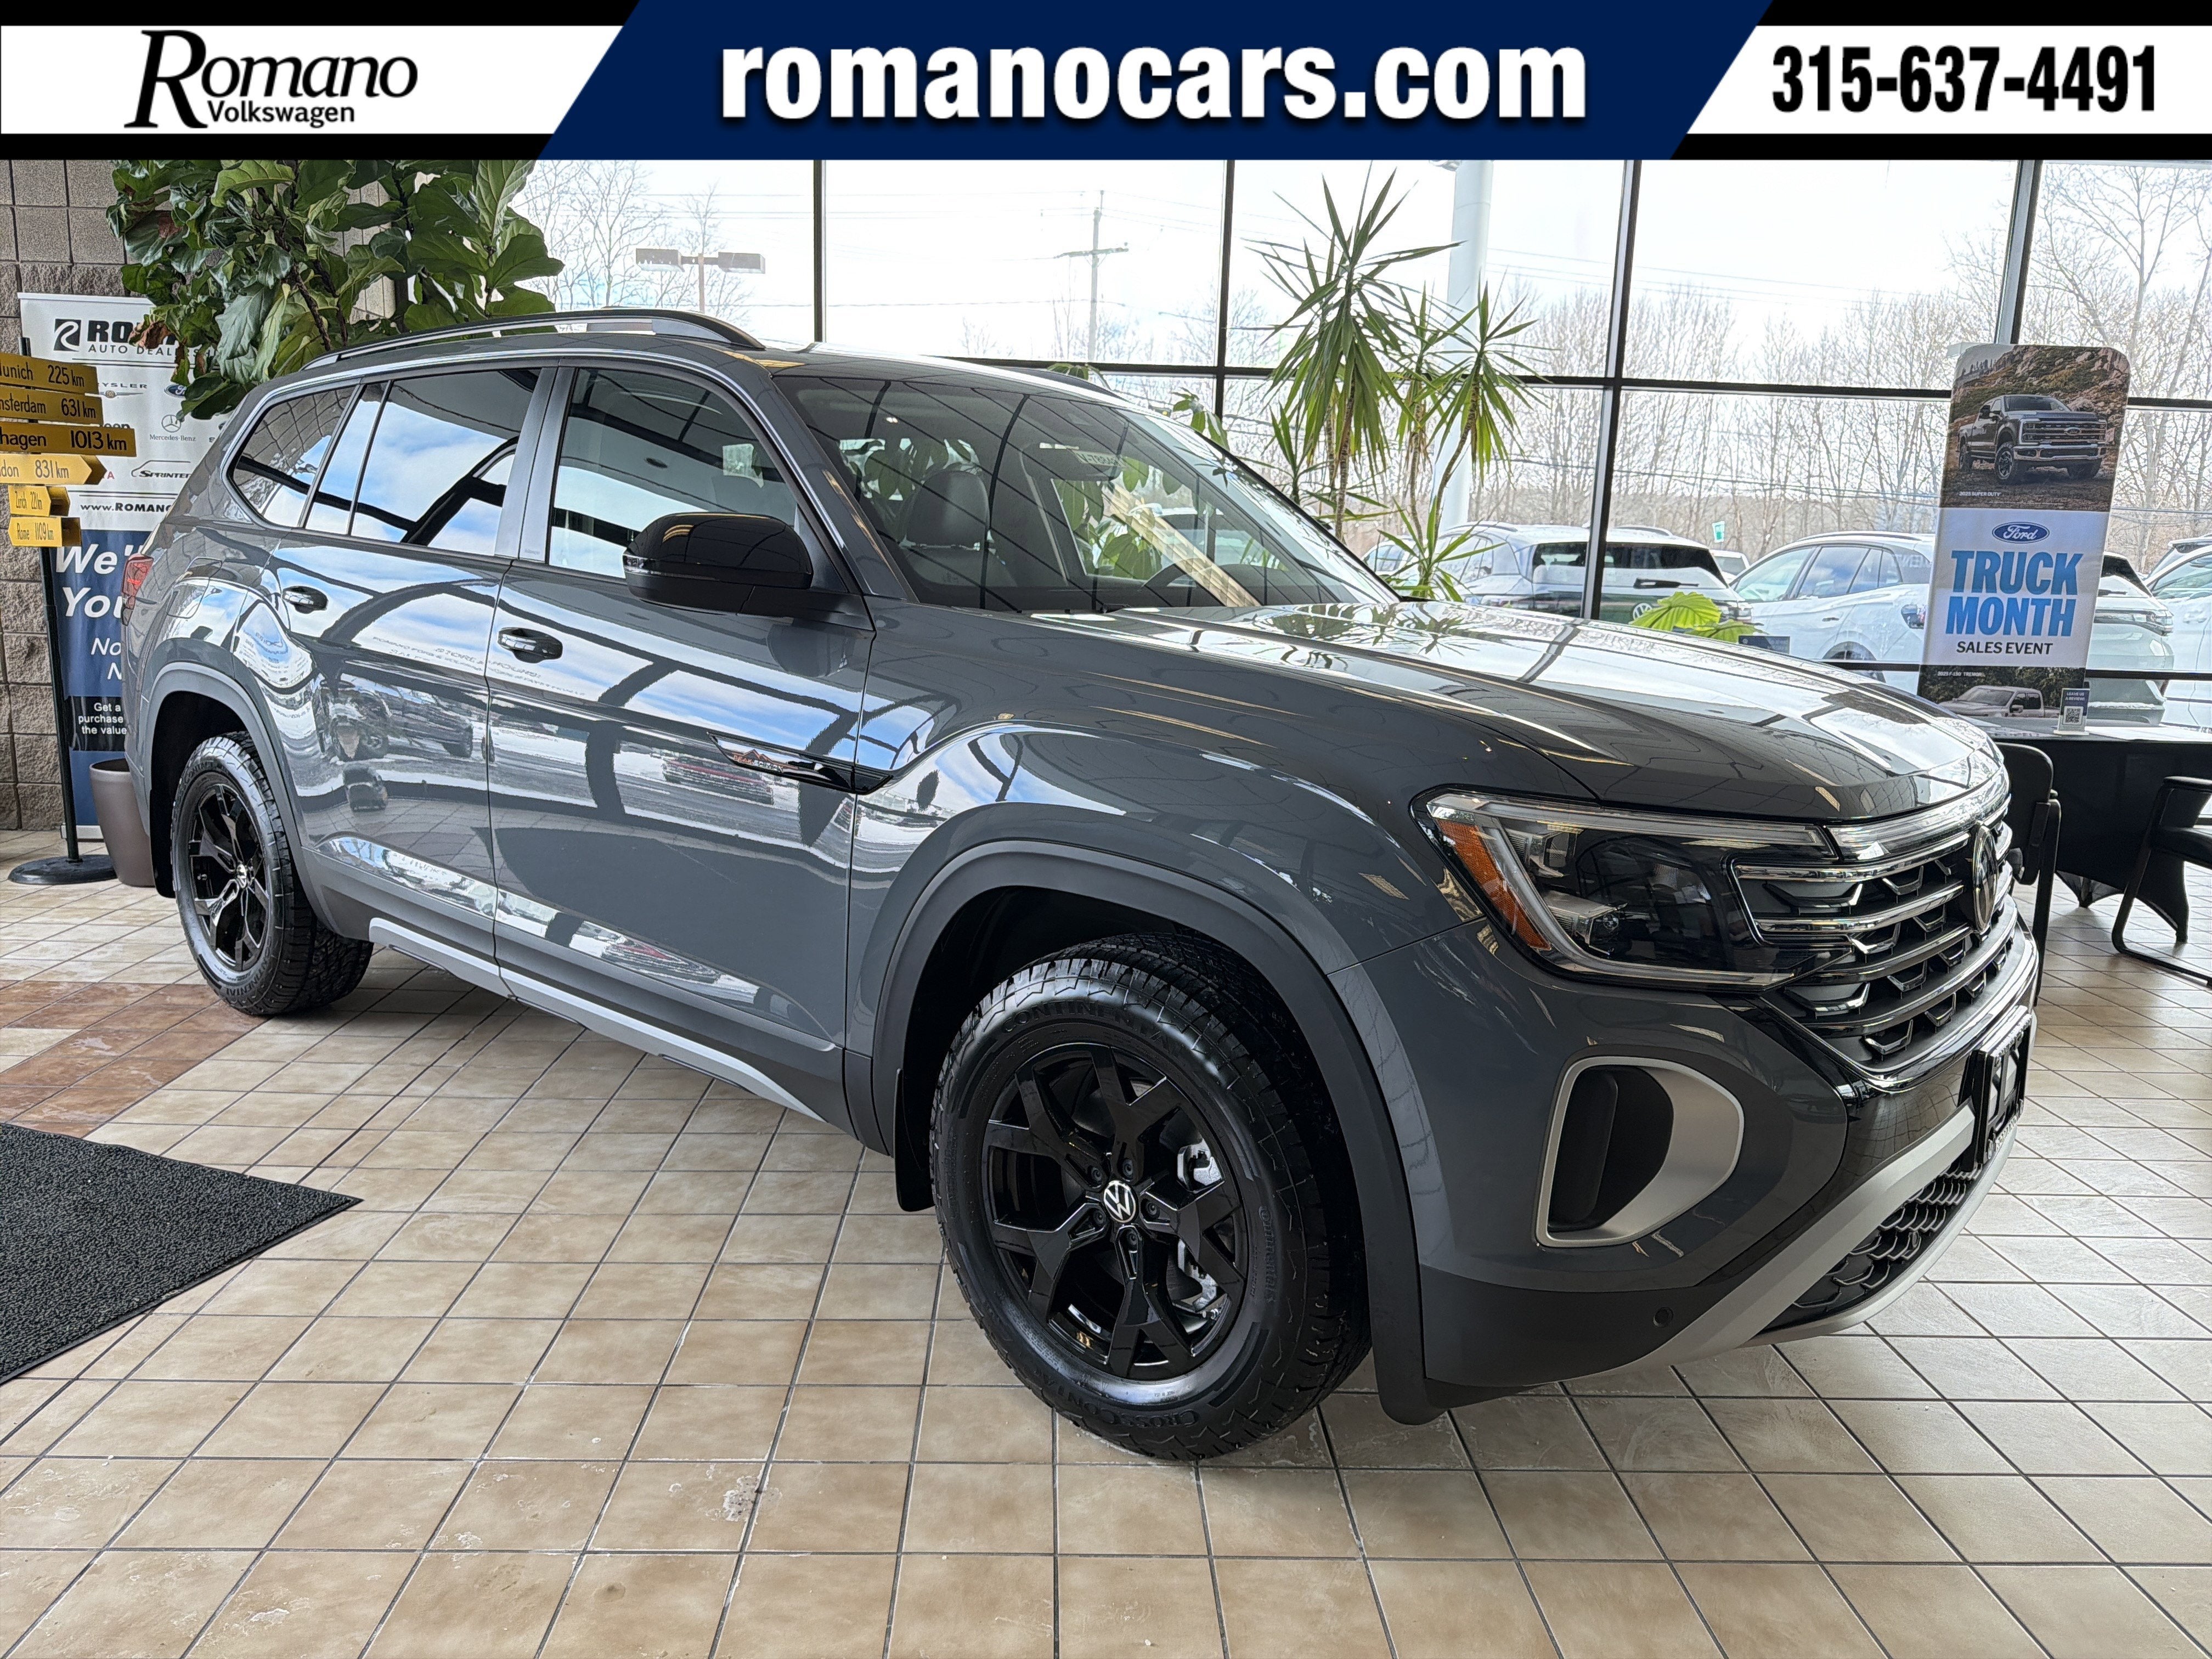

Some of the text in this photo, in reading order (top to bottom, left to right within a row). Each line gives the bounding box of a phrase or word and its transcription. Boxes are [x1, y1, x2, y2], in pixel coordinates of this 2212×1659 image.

[88, 343, 128, 354] AUTO
[0, 362, 84, 387] unich 225 km
[61, 398, 81, 417] 631
[83, 401, 96, 419] km
[71, 430, 104, 449] 1013
[107, 433, 127, 450] km
[150, 433, 196, 442] Mercedes-Benz
[35, 459, 53, 478] 831
[56, 461, 69, 478] km
[17, 522, 30, 540] Rome
[35, 522, 46, 540] 1109
[2003, 525, 2038, 540] Ford
[1951, 550, 2084, 596] TRUCK
[1945, 596, 2076, 637] MONTH
[1956, 641, 2053, 655] SALES EVENT
[94, 702, 121, 712] Get a
[78, 714, 123, 724] purchase
[81, 726, 127, 735] the value
[733, 755, 753, 765] PEAK
